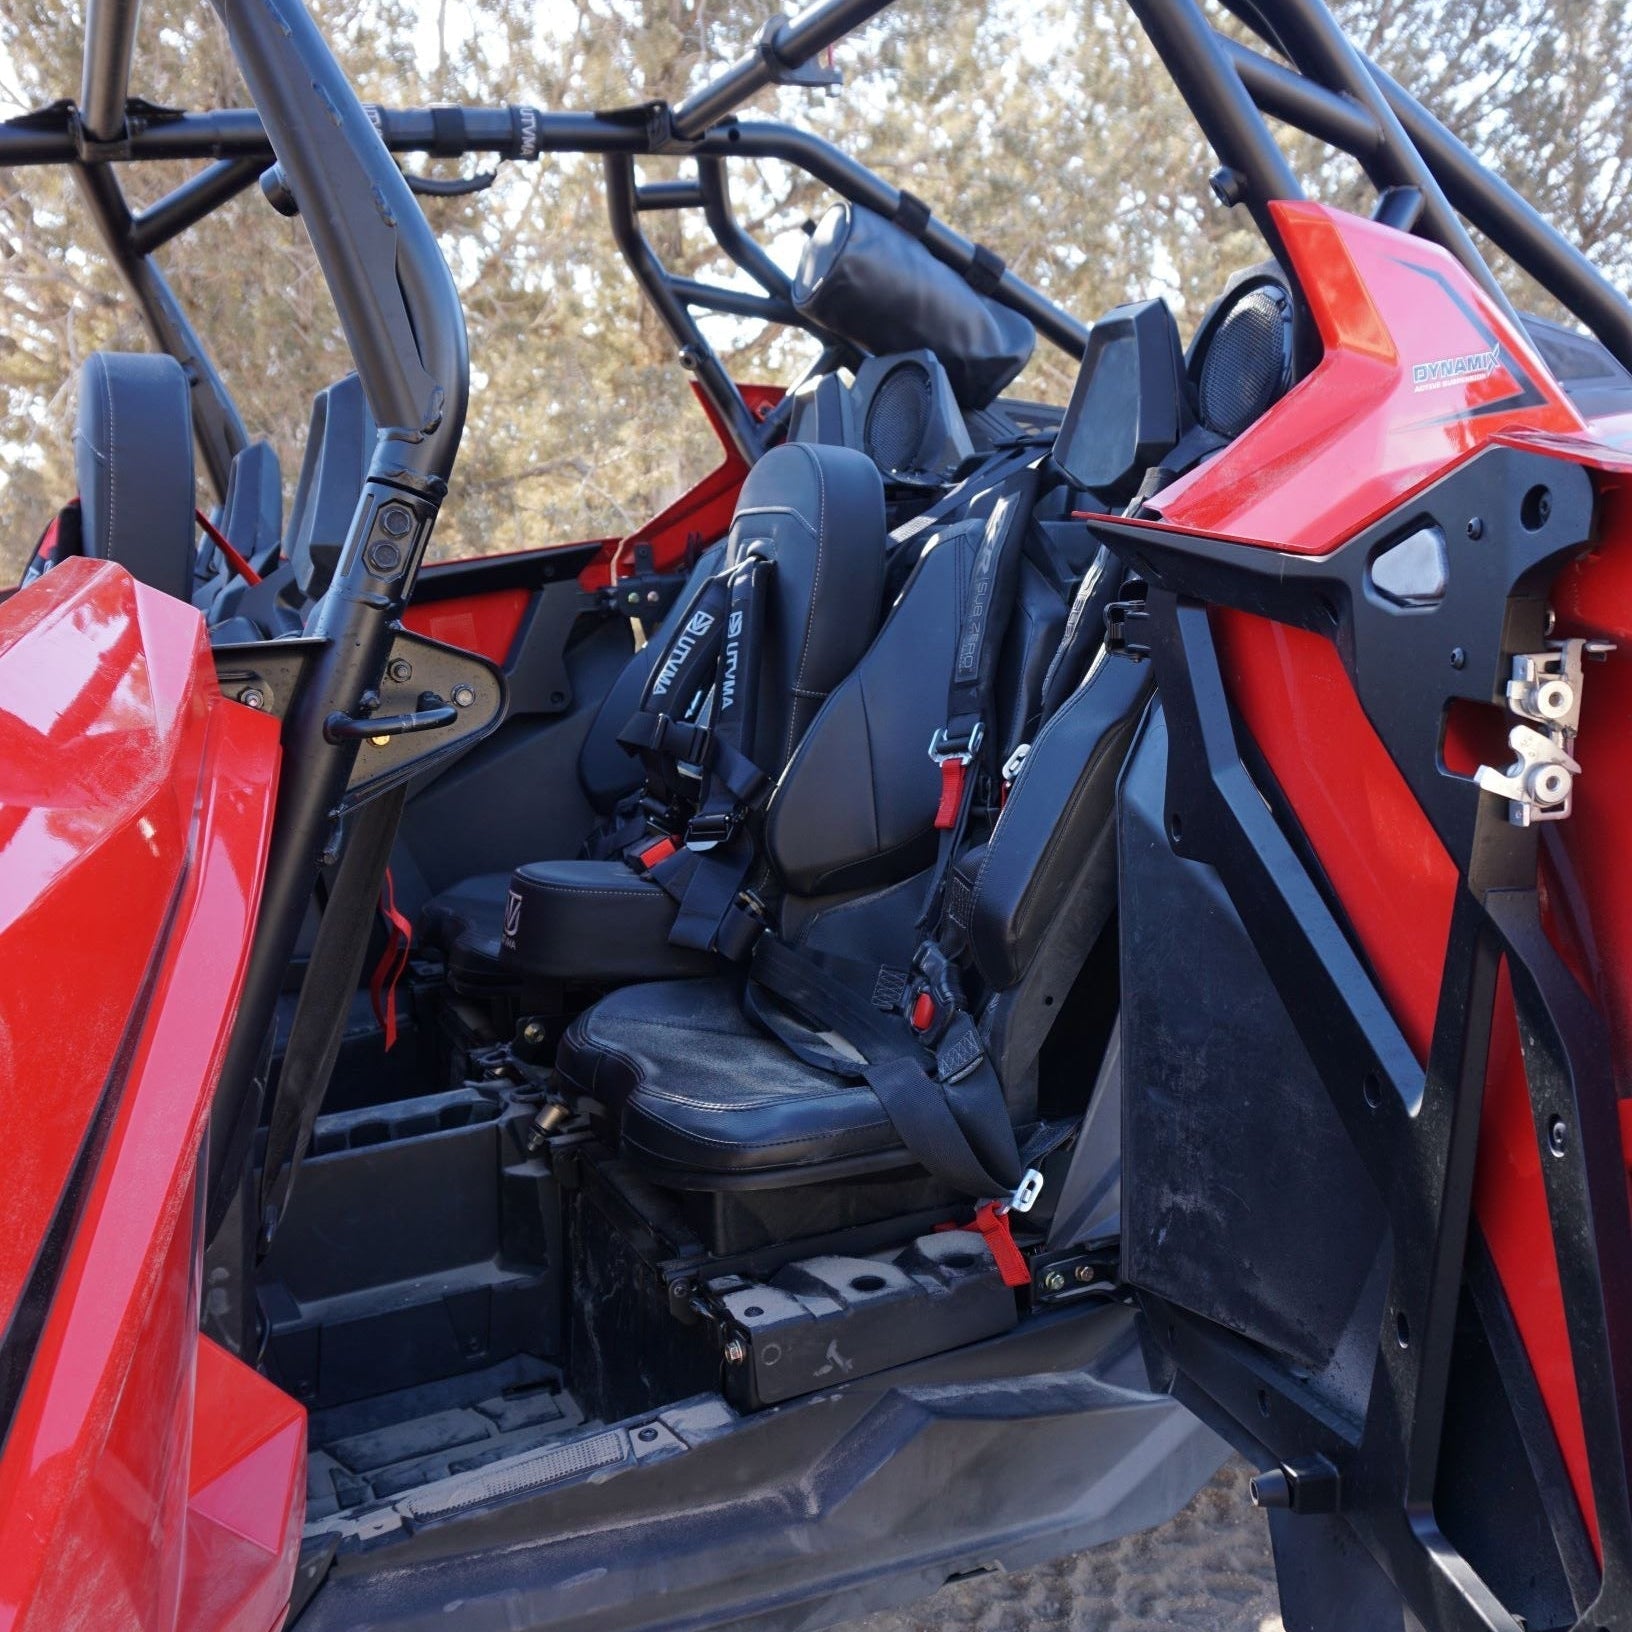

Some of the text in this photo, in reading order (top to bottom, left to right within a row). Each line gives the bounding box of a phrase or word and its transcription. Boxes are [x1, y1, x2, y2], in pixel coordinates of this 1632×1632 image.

[520, 107, 536, 155] UTVMA
[1413, 342, 1500, 383] DYNAMIX
[1414, 381, 1441, 393] ACTIVE
[653, 638, 696, 695] UTVMA
[722, 642, 739, 711] UTVMA
